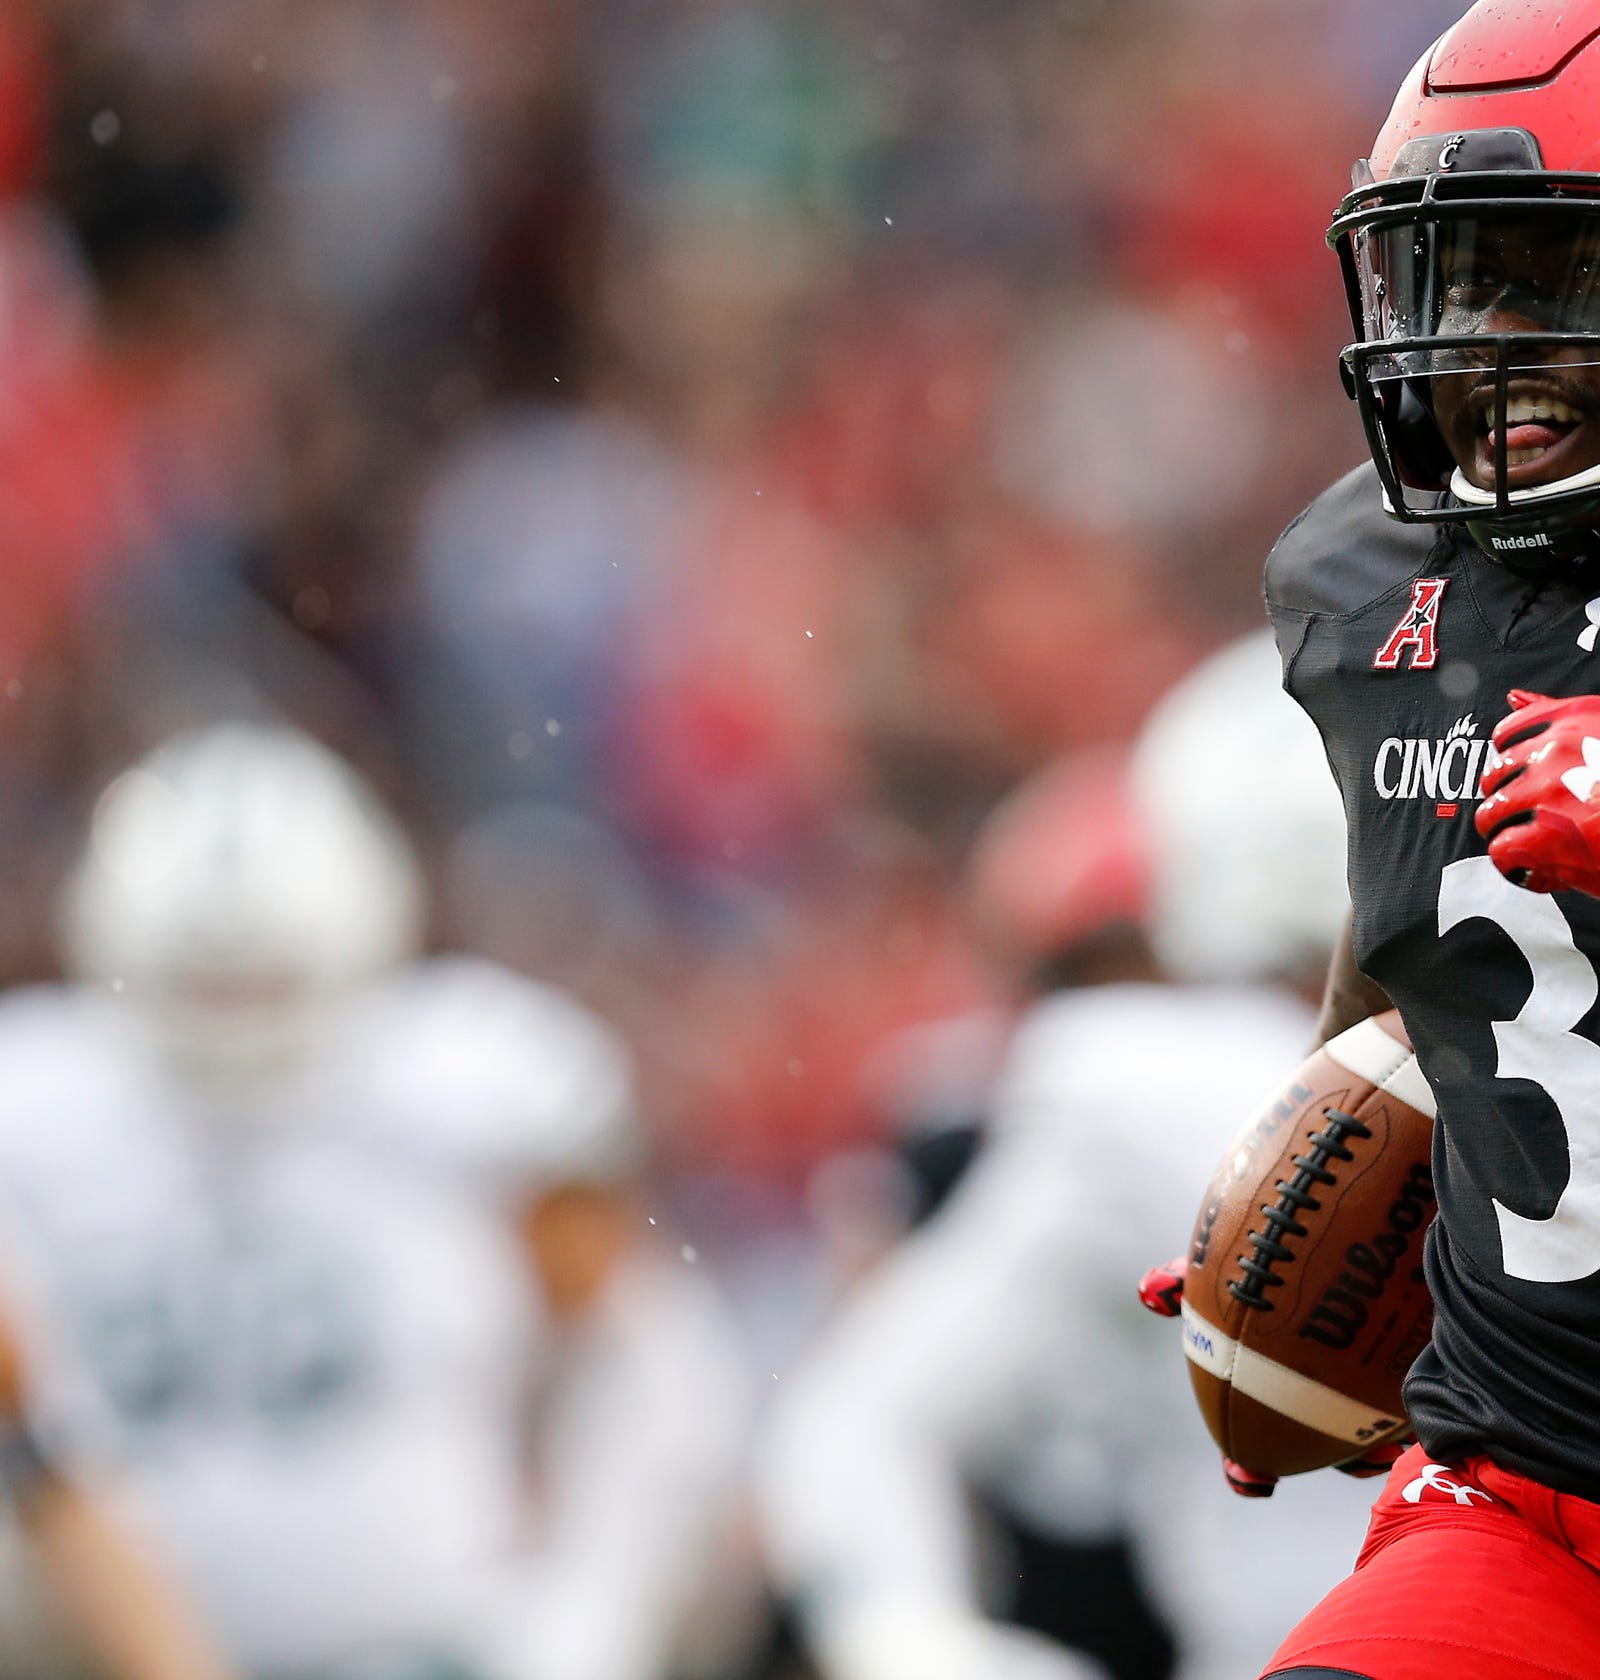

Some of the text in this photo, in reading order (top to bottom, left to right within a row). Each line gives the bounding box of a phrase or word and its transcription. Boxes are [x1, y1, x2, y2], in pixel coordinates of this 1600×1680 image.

[1491, 533, 1550, 550] Riddell
[1373, 578, 1449, 669] A
[1300, 1162, 1434, 1350] Wilson
